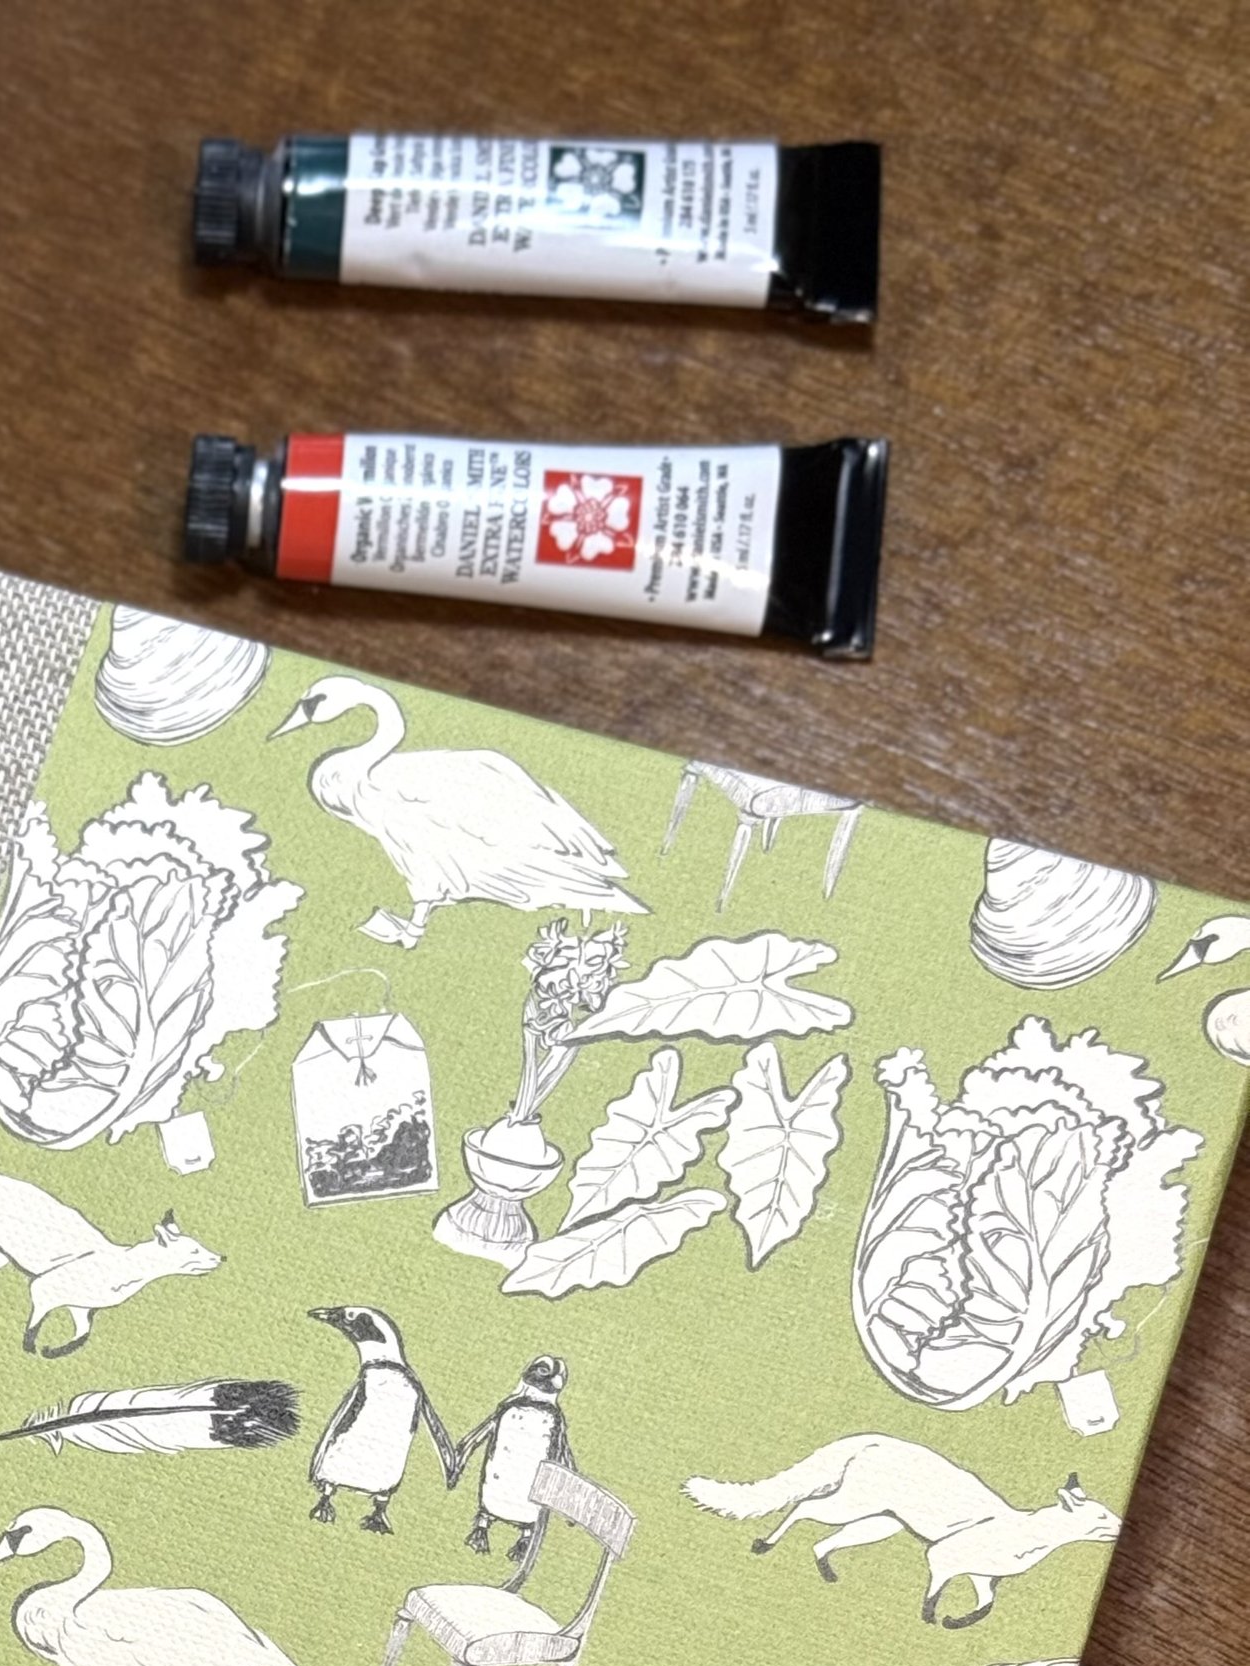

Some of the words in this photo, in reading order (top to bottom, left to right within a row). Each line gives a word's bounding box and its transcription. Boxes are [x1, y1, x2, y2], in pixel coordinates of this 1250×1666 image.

[466, 448, 486, 494] MITH
[350, 508, 372, 563] Organic
[653, 496, 671, 533] Artist
[672, 512, 687, 540] 610
[455, 505, 481, 579] DANIEL
[479, 514, 504, 577] EXTRA
